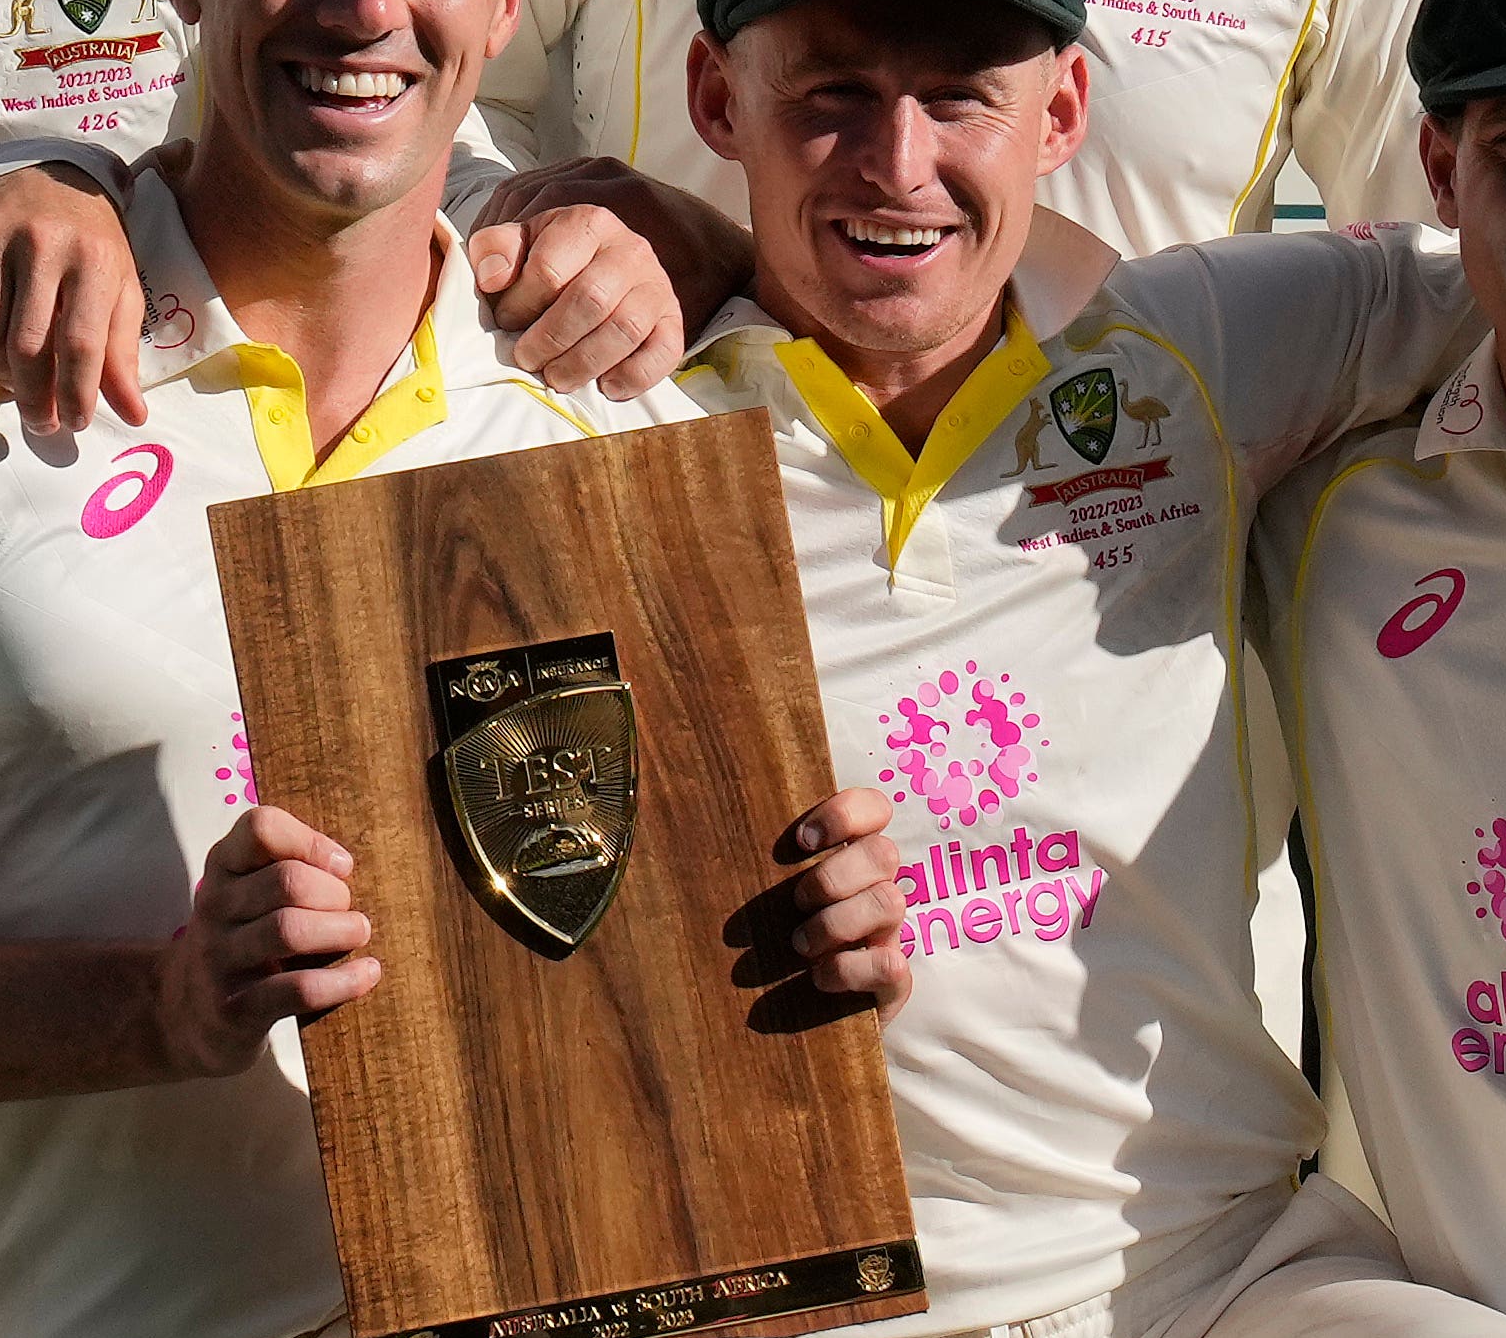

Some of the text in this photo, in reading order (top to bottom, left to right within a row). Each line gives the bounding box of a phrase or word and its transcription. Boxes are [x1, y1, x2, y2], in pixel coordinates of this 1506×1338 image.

[1146, 2, 1160, 15] &
[1163, 4, 1202, 23] South
[1206, 13, 1248, 31] Africa
[1131, 27, 1173, 48] 415
[51, 42, 131, 66] AUSTRALIA
[1, 71, 188, 114] West Indies & South Africa
[56, 66, 134, 91] 2022/2023
[77, 112, 120, 134] 426
[1057, 469, 1144, 503] AUSTRALIA
[1069, 496, 1145, 525] 2022/2023
[1018, 502, 1203, 554] West Indies & South Africa
[1094, 544, 1136, 571] 455
[894, 826, 1082, 910] alinta
[636, 1283, 705, 1314] SOUTH
[713, 1270, 792, 1299] AFRICA
